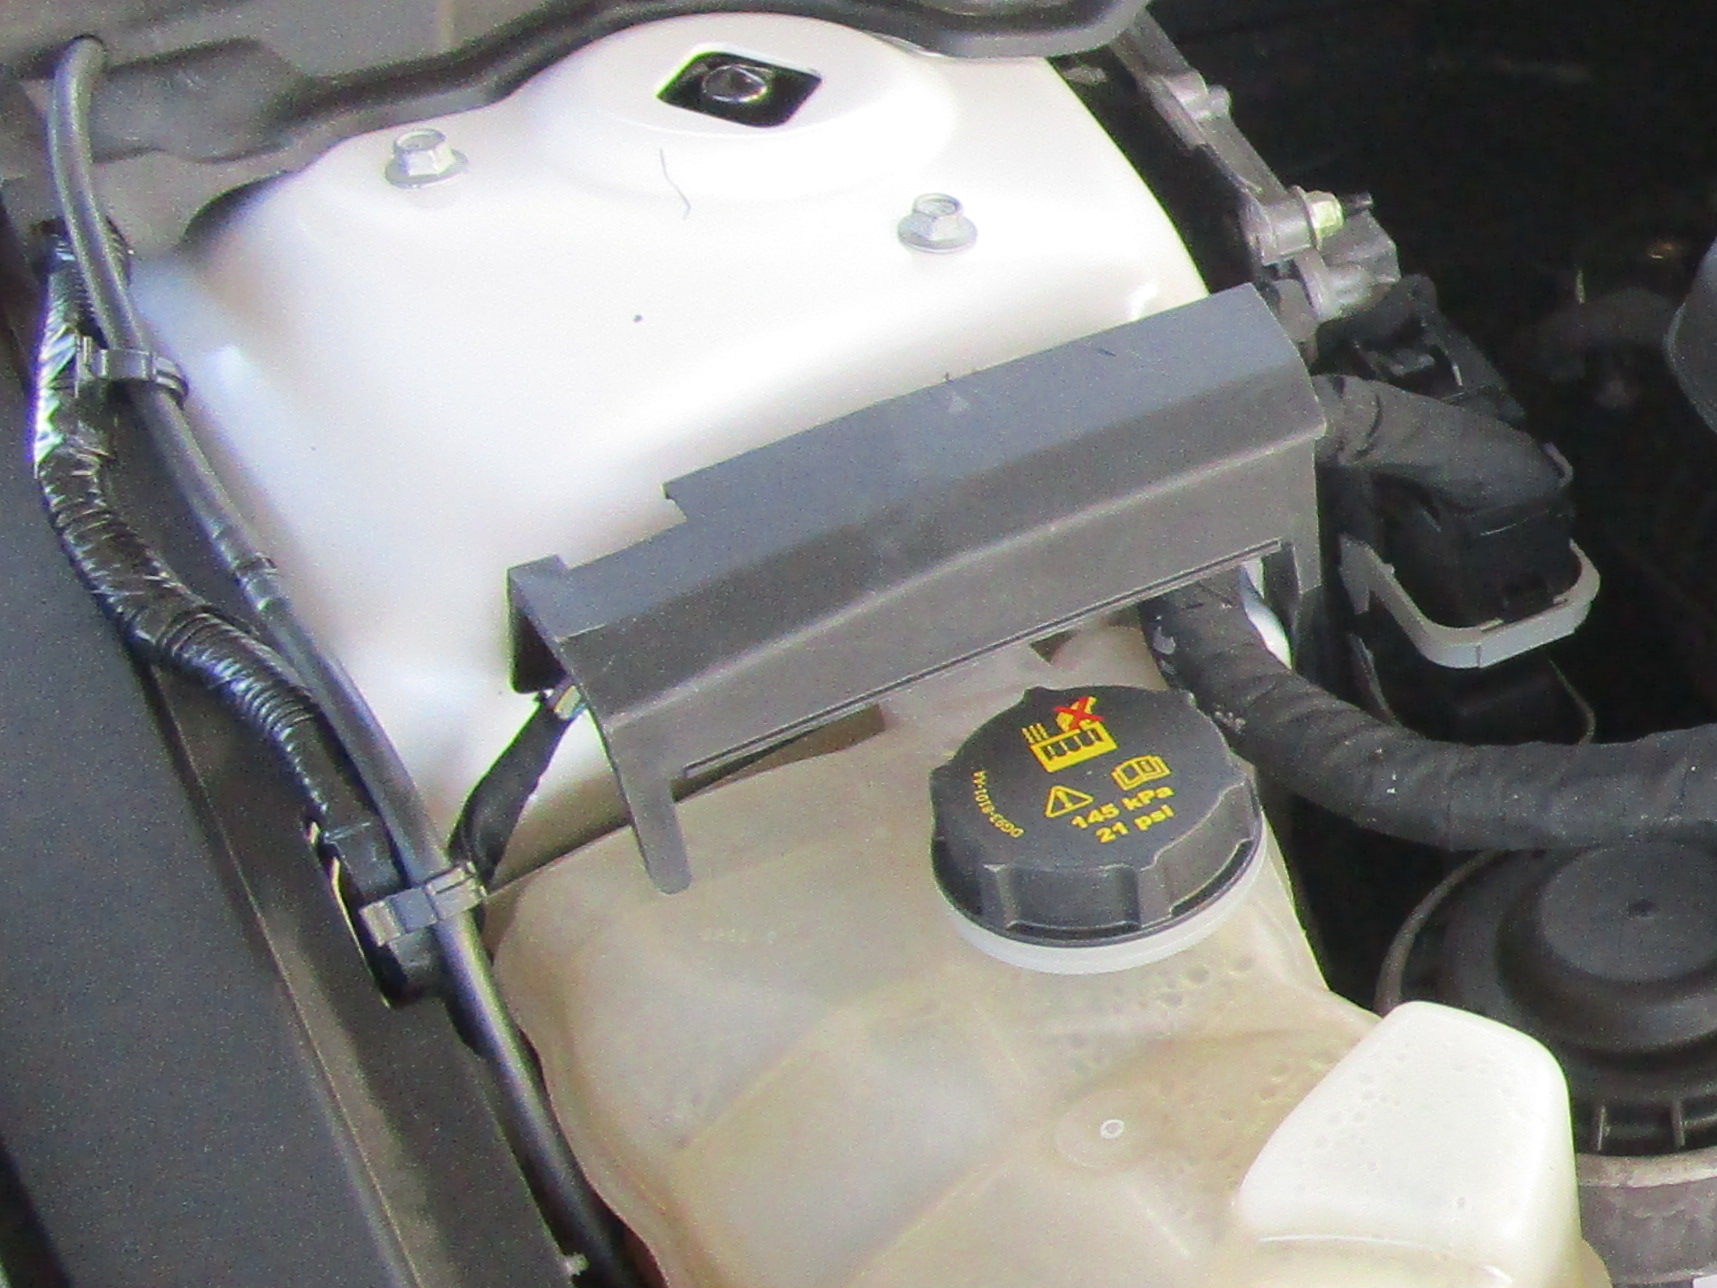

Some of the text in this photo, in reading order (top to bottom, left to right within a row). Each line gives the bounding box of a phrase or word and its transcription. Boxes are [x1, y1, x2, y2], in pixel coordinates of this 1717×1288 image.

[1070, 785, 1177, 830] 145 kPa
[1095, 803, 1176, 844] 21 psi
